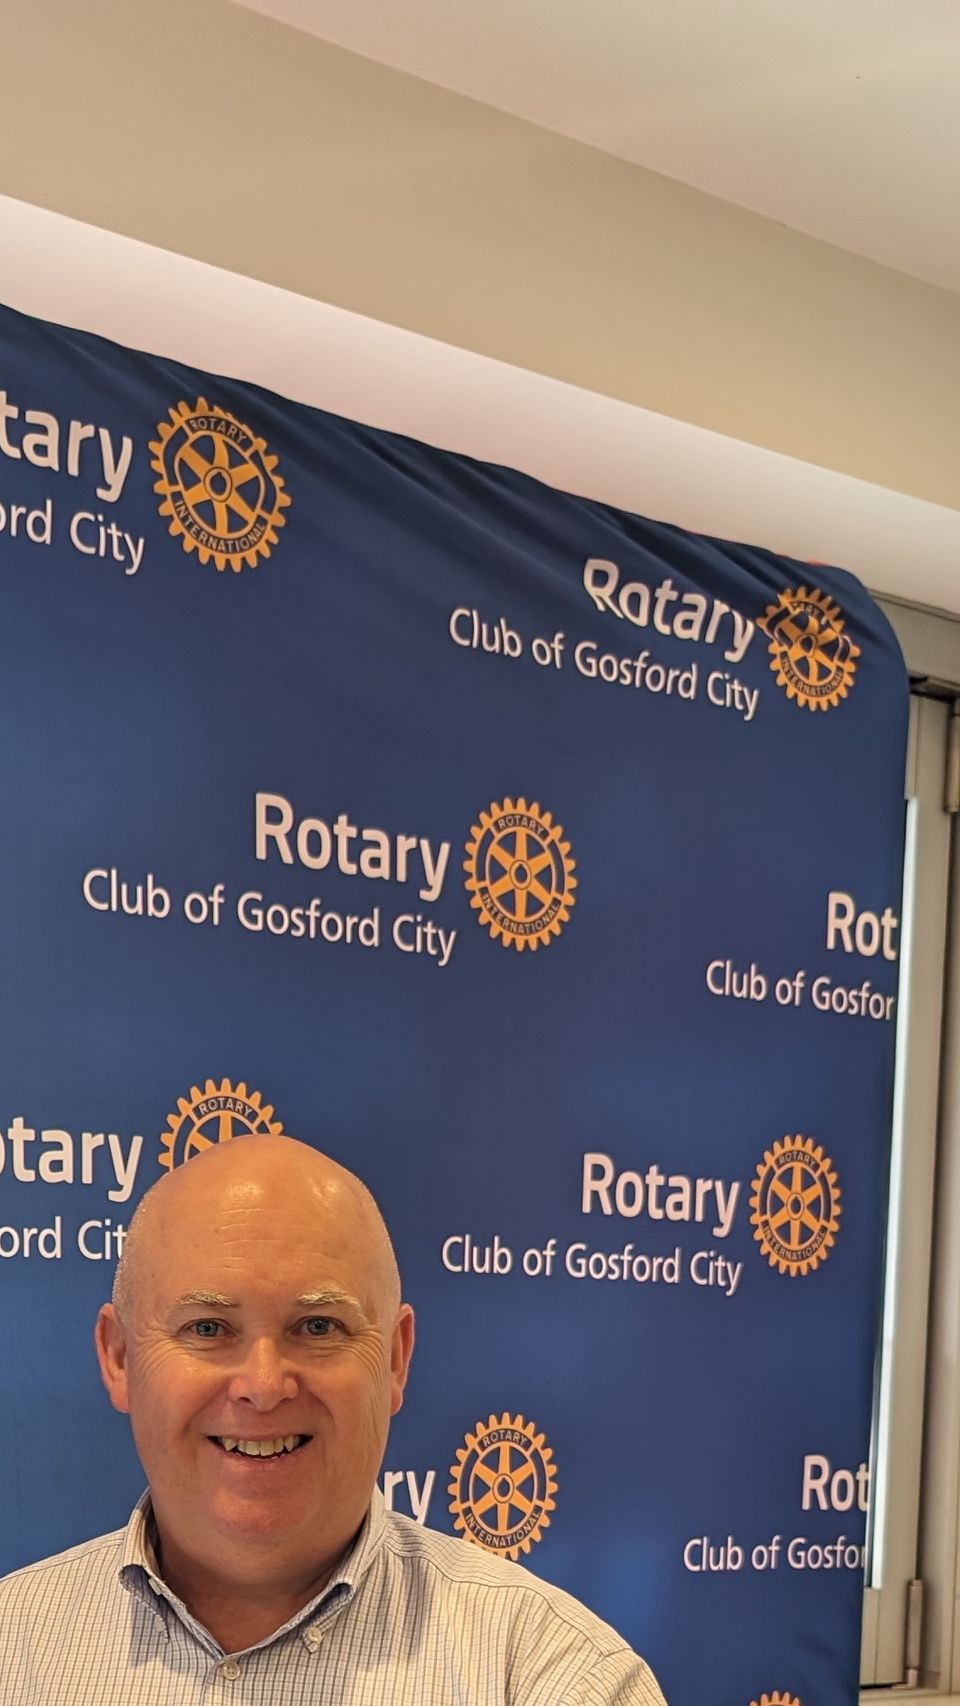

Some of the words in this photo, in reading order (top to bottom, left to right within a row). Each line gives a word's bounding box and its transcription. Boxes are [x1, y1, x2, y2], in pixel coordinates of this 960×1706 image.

[190, 417, 247, 442] ROTARY
[70, 511, 145, 576] City
[175, 499, 266, 554] INTERNATIONAL
[583, 559, 755, 663] Rotary
[449, 608, 523, 658] Club
[531, 632, 564, 669] of
[574, 641, 698, 700] Gosford
[707, 671, 759, 721] City
[255, 792, 451, 902] Rotary
[498, 816, 544, 836] ROTARY
[83, 868, 171, 919] Club
[184, 883, 225, 926] of
[237, 891, 380, 947] Gosford
[392, 914, 457, 967] City
[482, 893, 560, 934] INTERNATIONAL
[826, 891, 898, 961] Rot
[706, 959, 767, 1001] Club
[775, 970, 805, 1006] of
[811, 976, 895, 1020] Gosfor
[198, 1098, 253, 1118] ROTARY
[779, 1151, 816, 1169] ROTARY
[582, 1153, 741, 1238] Rotary
[77, 1218, 128, 1261] Cit
[442, 1233, 513, 1275] Club
[522, 1238, 557, 1277] of
[565, 1242, 681, 1284] Gosford
[690, 1248, 743, 1297] City
[482, 1429, 528, 1447] ROTARY
[801, 1454, 869, 1512] Rot
[683, 1535, 744, 1572] Club
[751, 1535, 781, 1570] of
